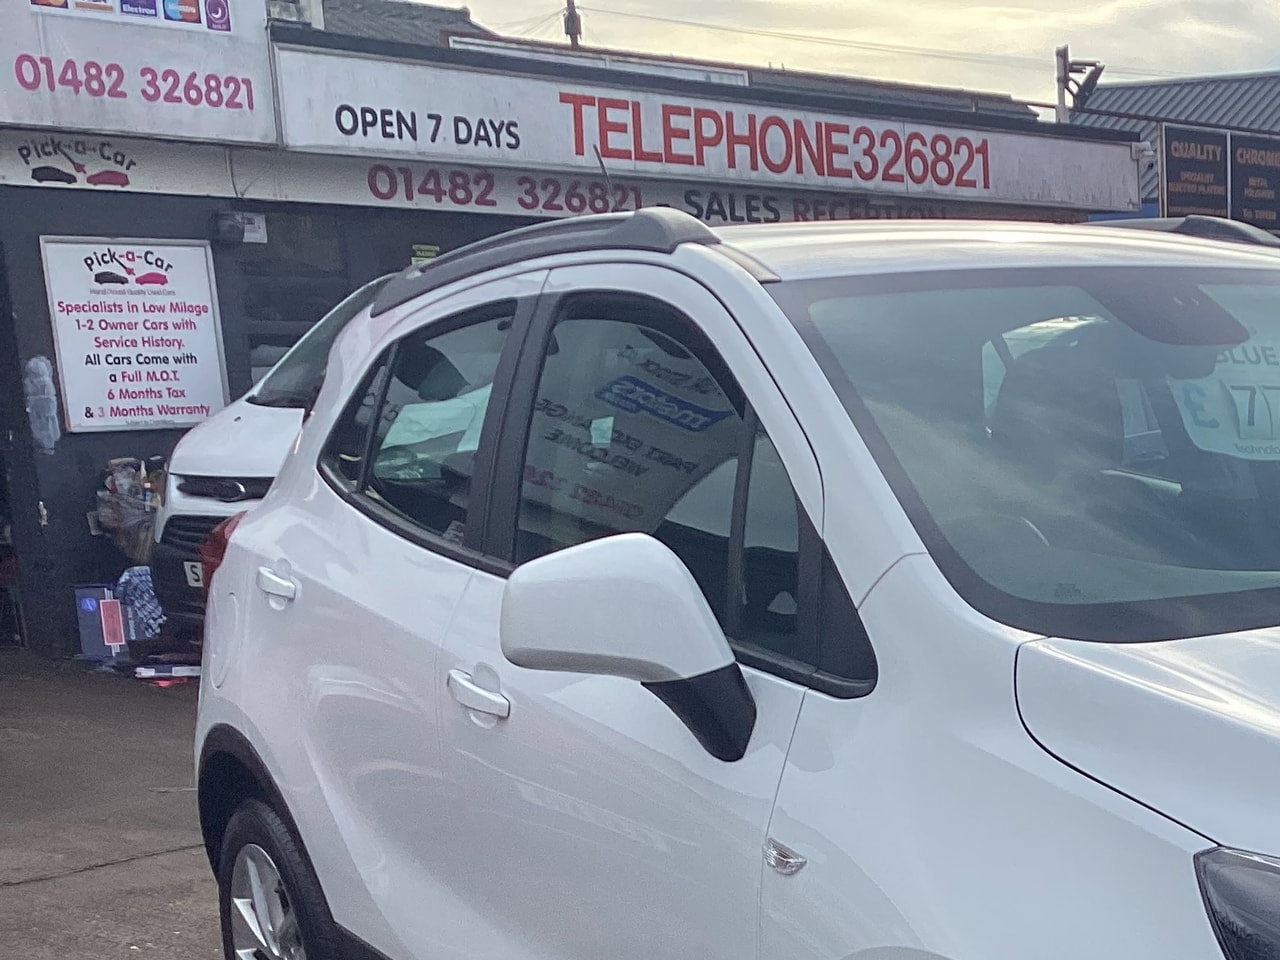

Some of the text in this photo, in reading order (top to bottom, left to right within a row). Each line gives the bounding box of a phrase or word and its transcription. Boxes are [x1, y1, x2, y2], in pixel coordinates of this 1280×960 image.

[122, 4, 156, 15] Electron
[14, 53, 255, 111] 01482 326821
[335, 104, 521, 150] OPEN 7 DAYS
[1171, 141, 1222, 162] QUALITY
[1236, 147, 1280, 168] CHROME
[367, 164, 498, 207] 01482
[517, 176, 642, 213] 326821
[683, 189, 781, 224] SALES
[57, 301, 209, 317] Specialists in Low Milage
[75, 319, 197, 331] 1-2 Owner Cars with
[94, 336, 185, 350] Service History.
[85, 353, 198, 366] All Cars Come with
[109, 373, 117, 383] a
[121, 370, 142, 383] Full
[107, 387, 186, 401] 6 Months Tax
[84, 404, 210, 419] & 3 Months Warranty
[190, 564, 201, 583] S
